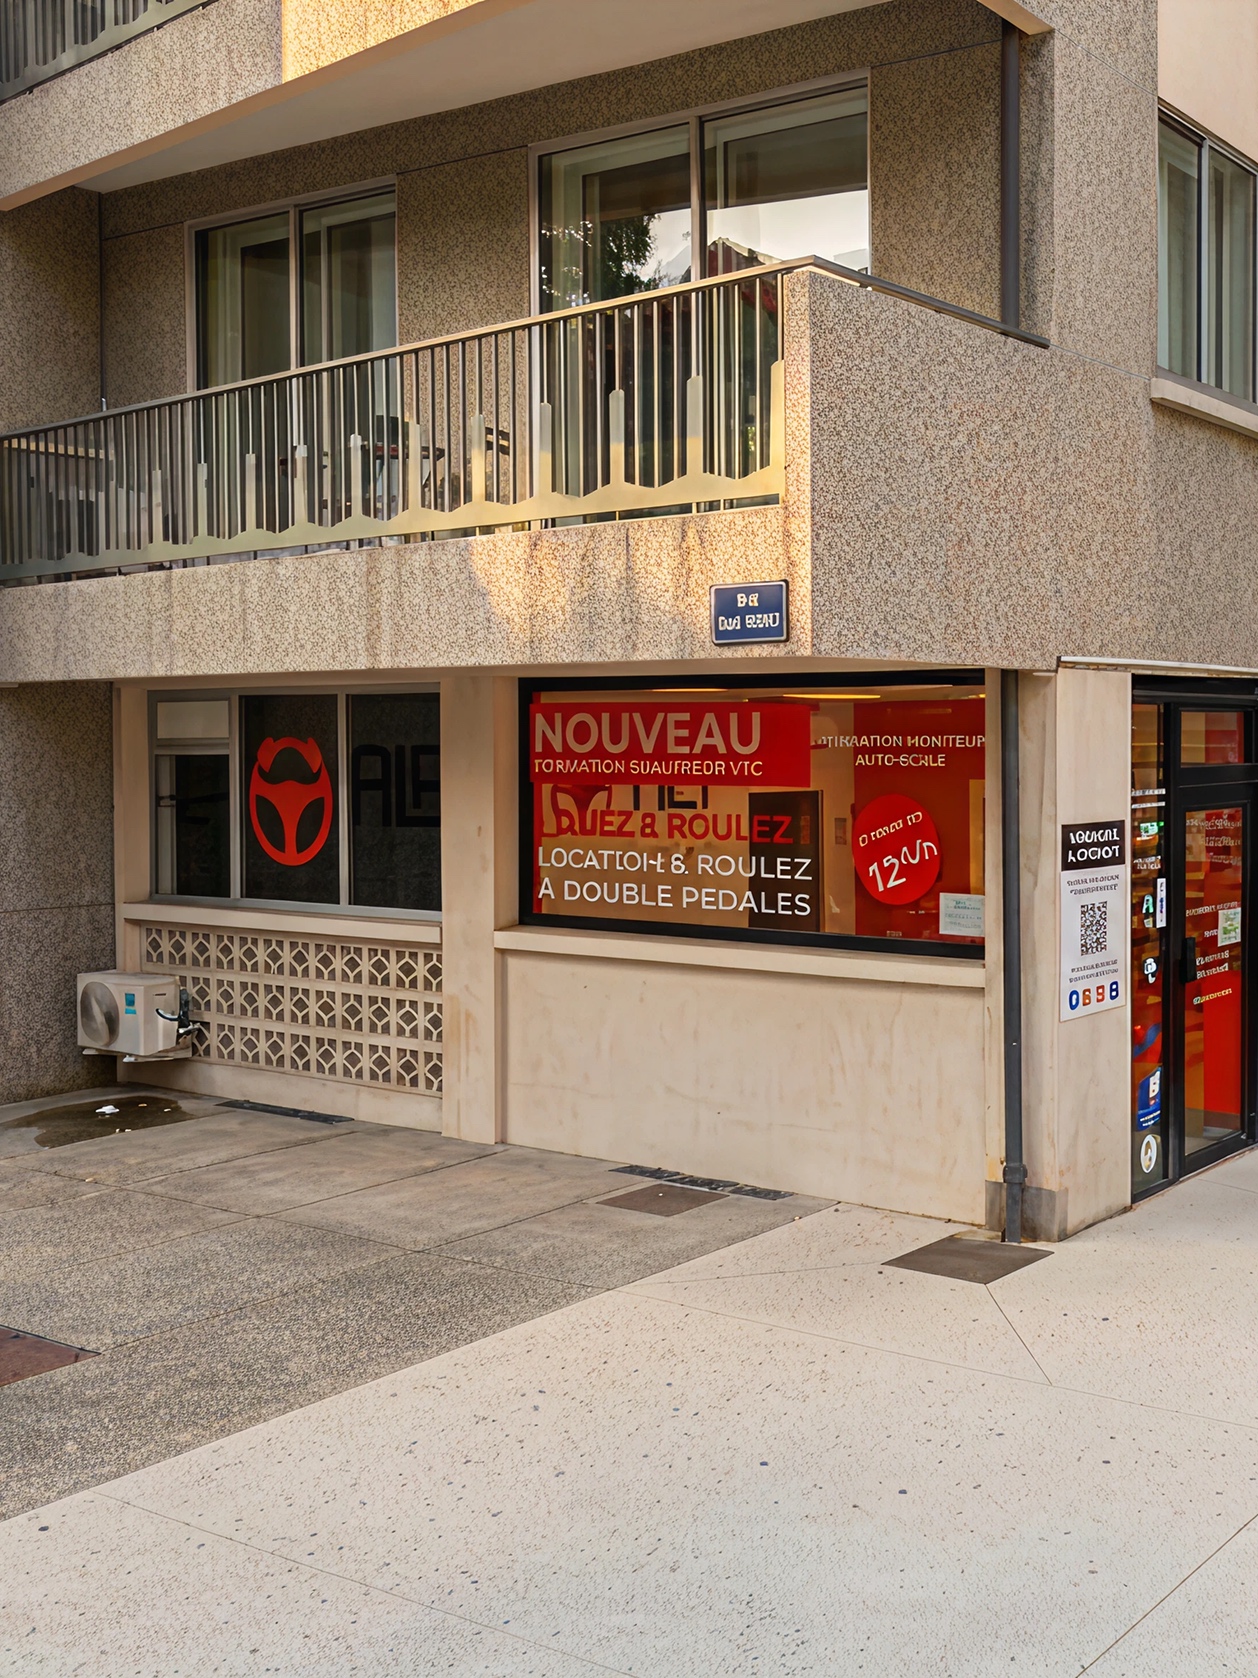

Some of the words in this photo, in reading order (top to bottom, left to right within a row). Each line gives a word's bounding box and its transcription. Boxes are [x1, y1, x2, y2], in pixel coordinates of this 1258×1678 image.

[535, 712, 761, 754] NOUVEAU
[668, 813, 794, 844] ROULEZ
[698, 854, 813, 880] ROULEZ
[564, 880, 673, 907] DOUBLE
[682, 886, 811, 916] PEDALES
